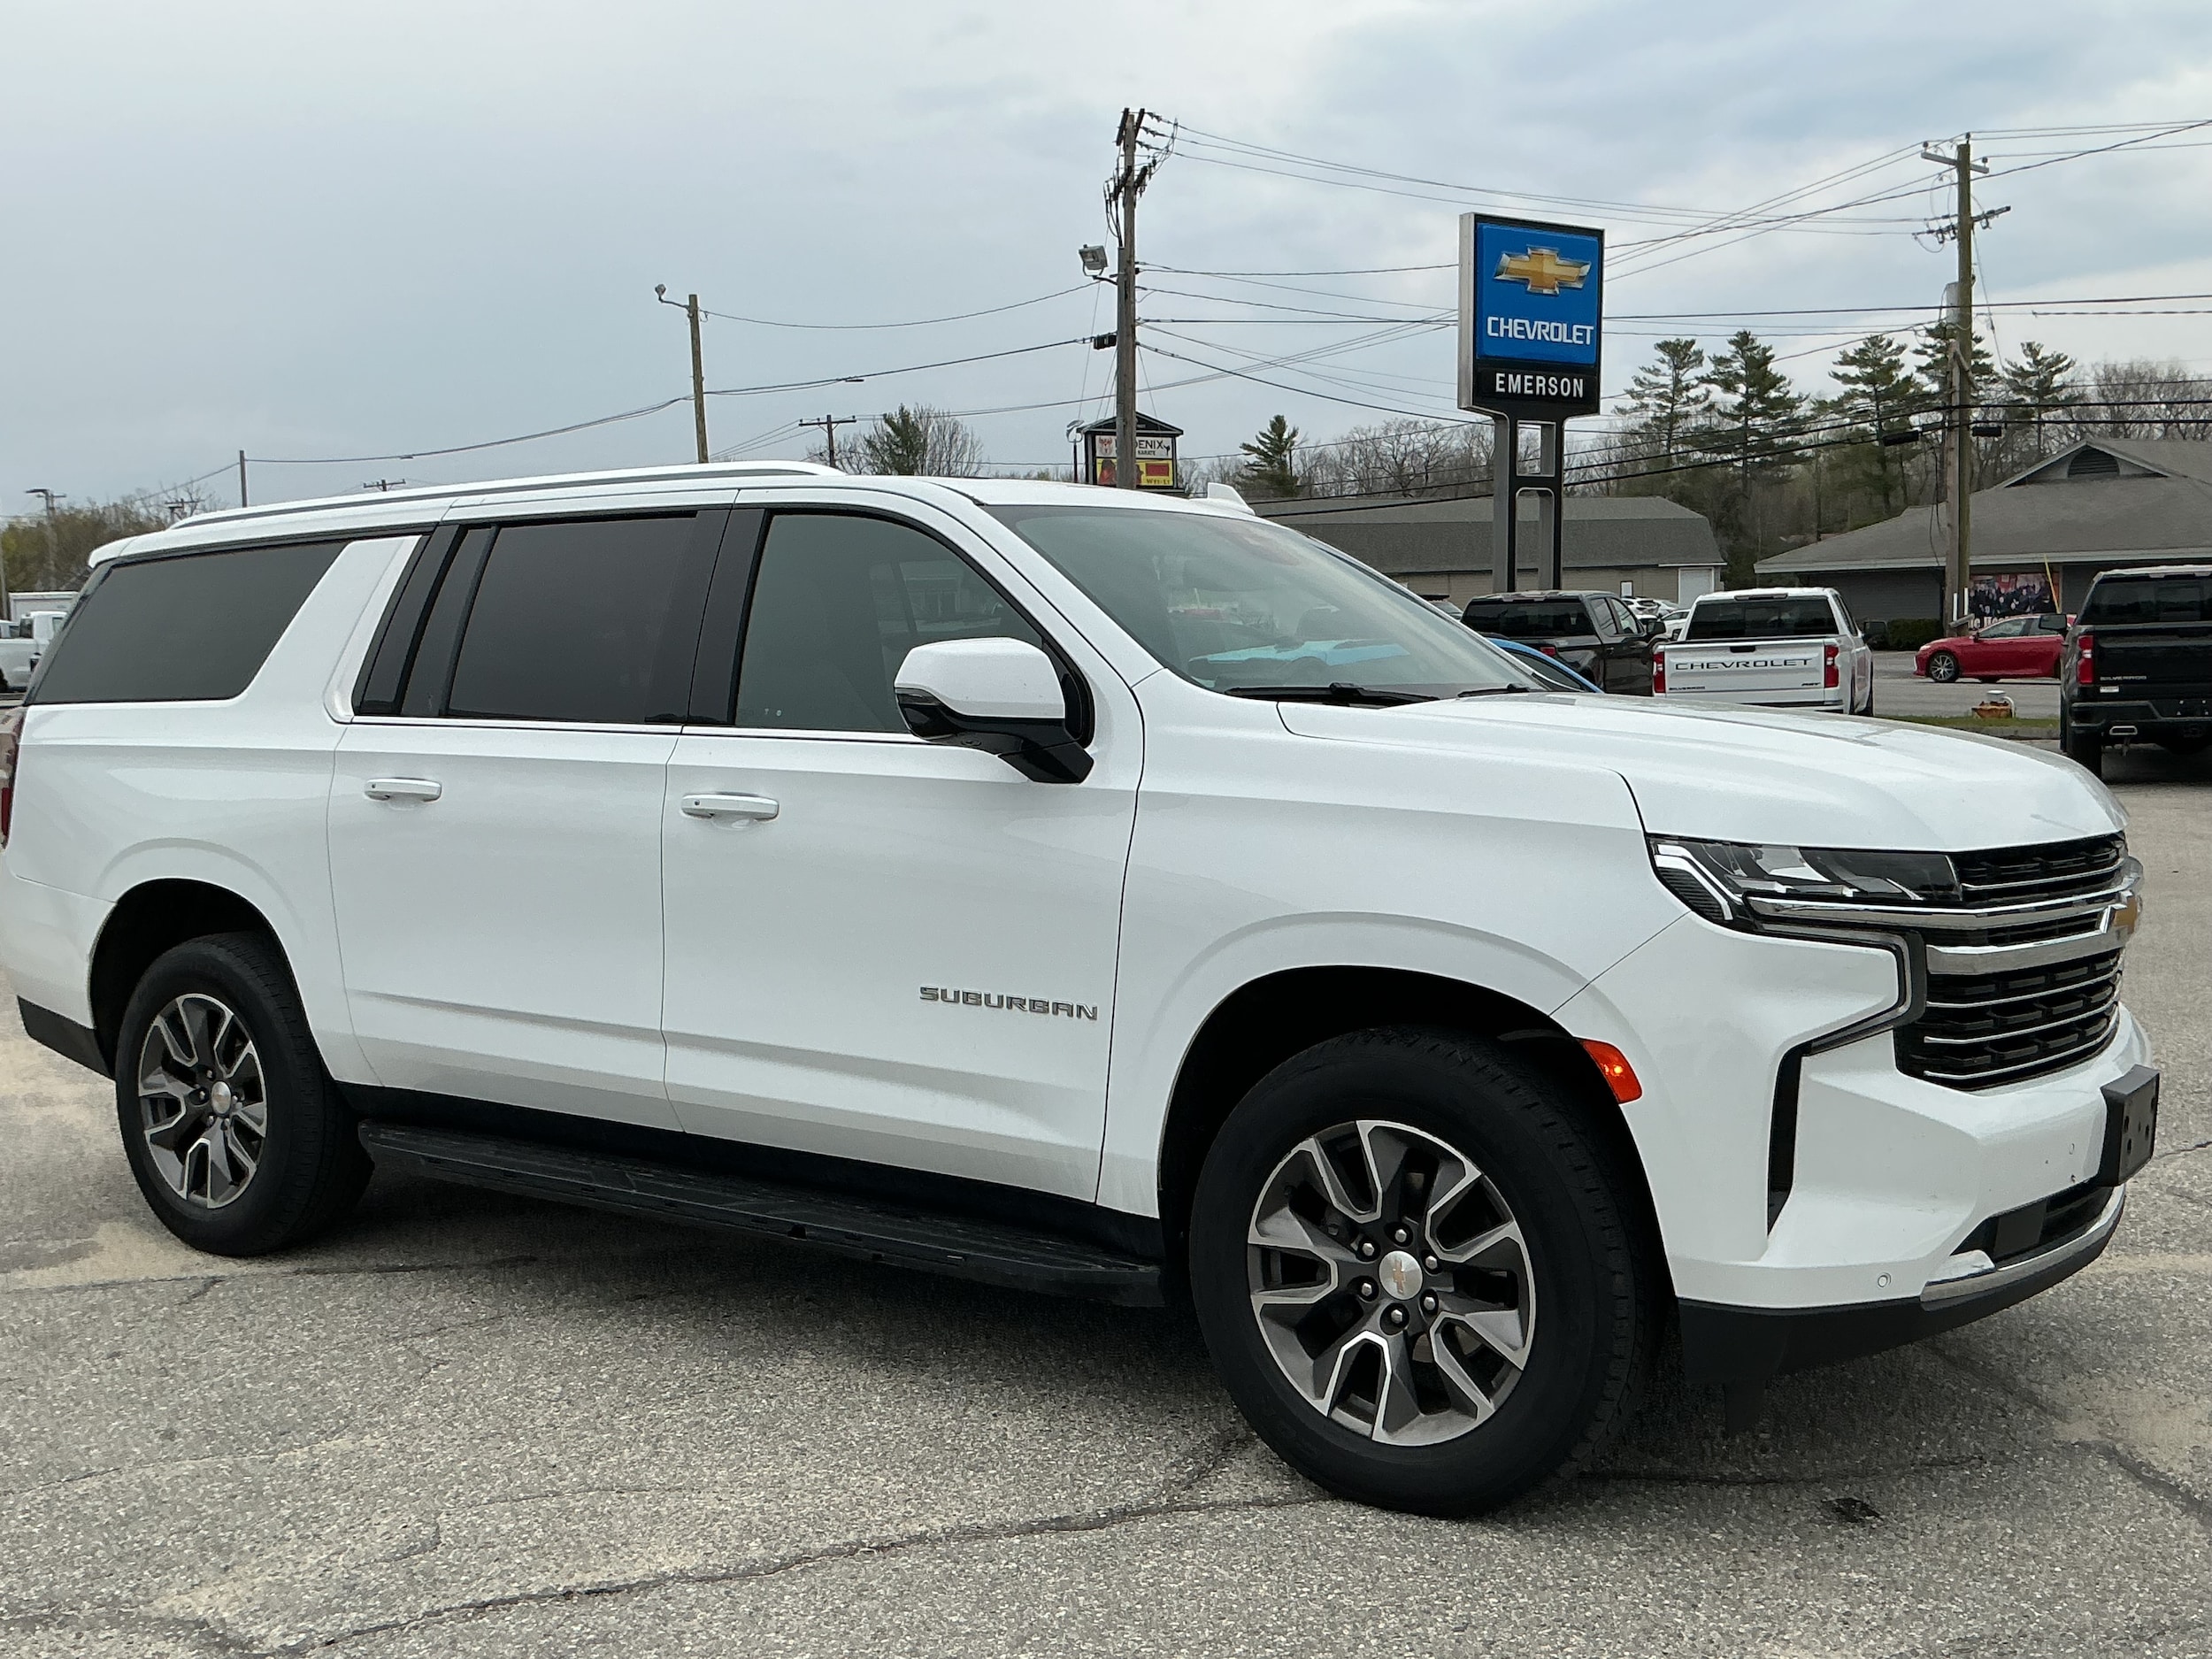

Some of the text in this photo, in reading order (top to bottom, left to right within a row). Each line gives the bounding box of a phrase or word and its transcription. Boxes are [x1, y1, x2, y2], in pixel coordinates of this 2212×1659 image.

[1487, 316, 1594, 345] CHEVROLET
[1495, 373, 1584, 397] EMERSON
[1675, 658, 1812, 671] CHEVROLET
[919, 987, 1098, 1020] SUBURBAN
